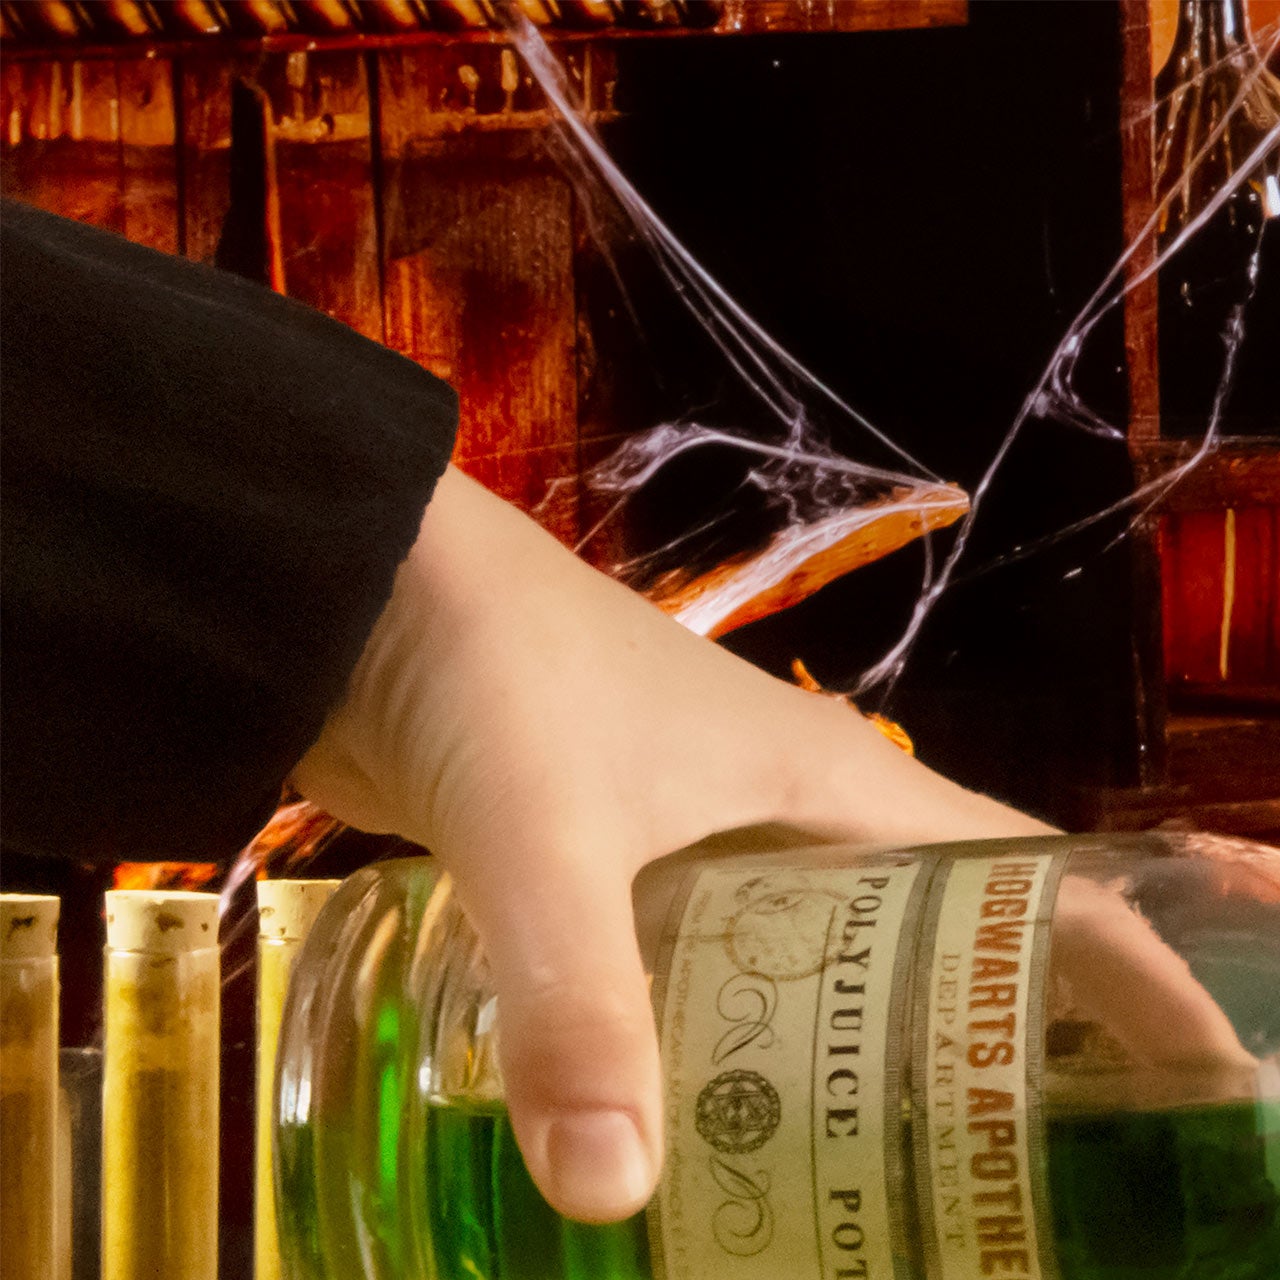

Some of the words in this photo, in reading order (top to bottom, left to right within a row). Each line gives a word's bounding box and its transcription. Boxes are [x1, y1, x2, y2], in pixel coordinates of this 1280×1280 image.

[826, 874, 891, 1140] POLYJUICE
[966, 861, 1039, 1071] HOGWARTS
[935, 952, 964, 1250] DEPARTMENT
